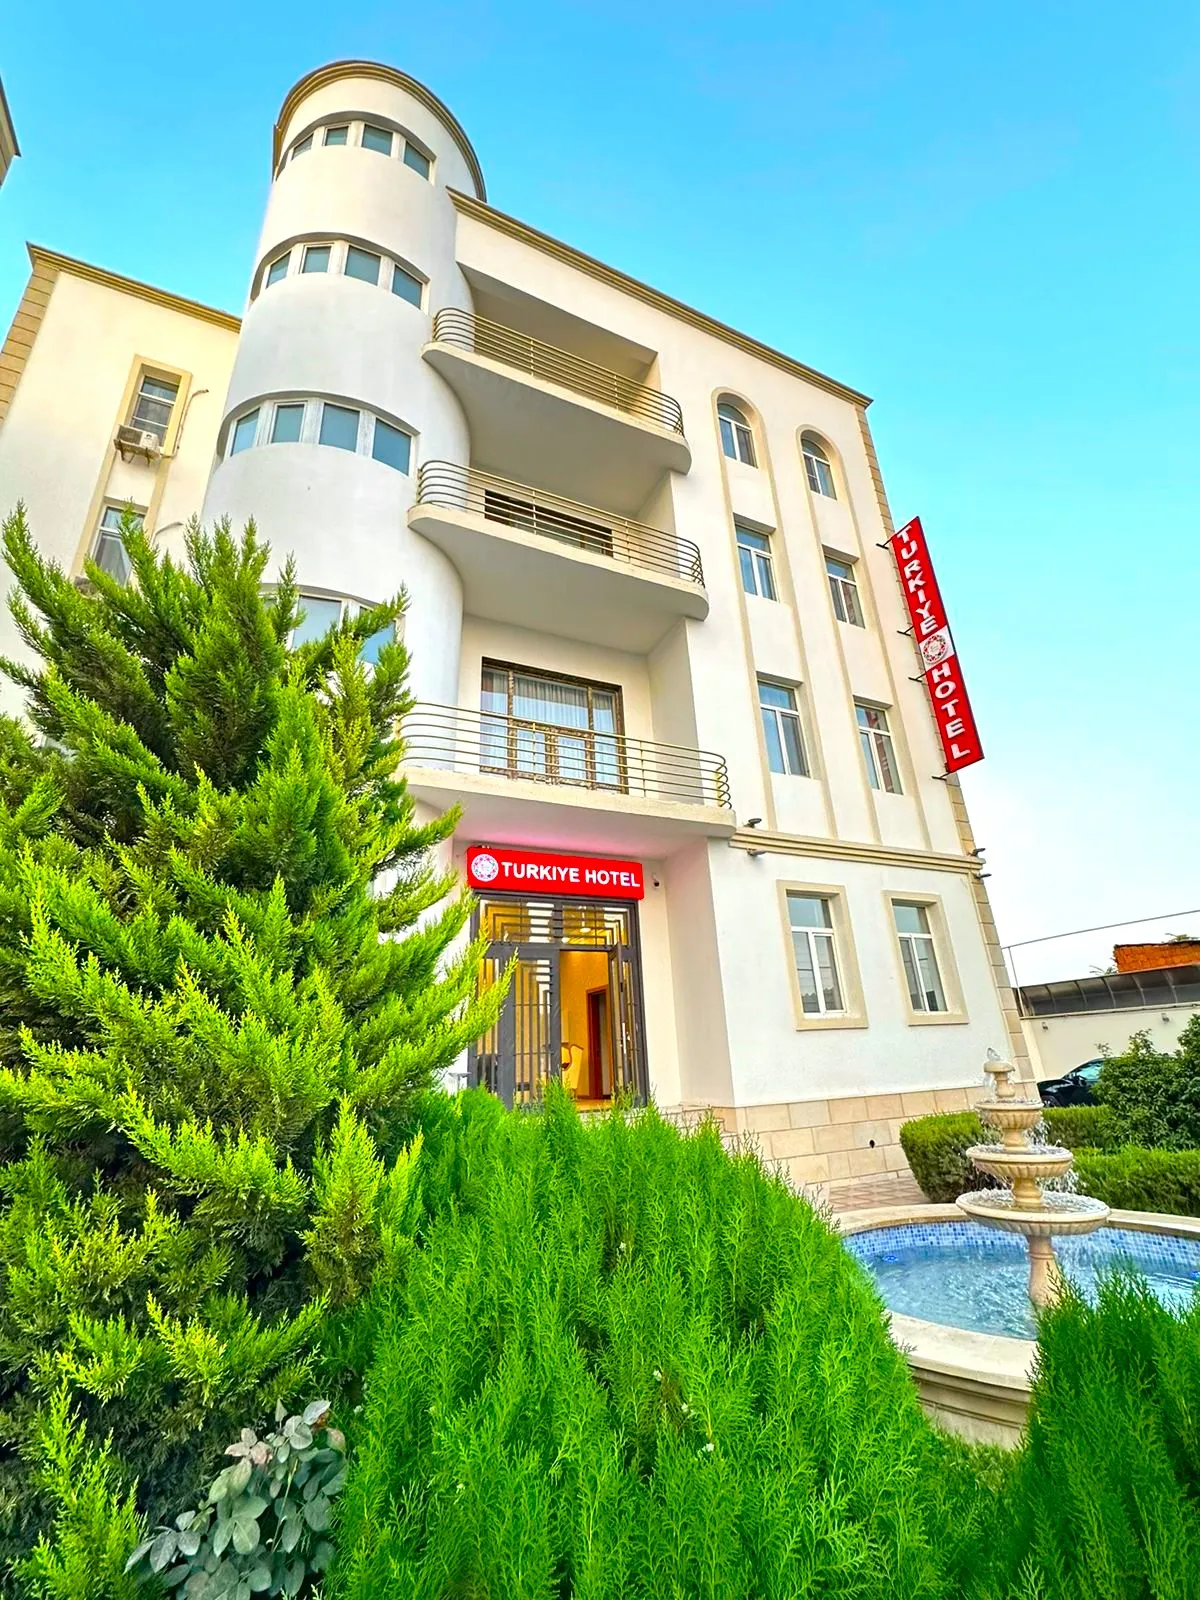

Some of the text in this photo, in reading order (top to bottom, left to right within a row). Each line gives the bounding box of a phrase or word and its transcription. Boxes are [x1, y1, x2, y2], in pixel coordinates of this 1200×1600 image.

[897, 525, 971, 760] TURKIYE HOTEL
[501, 861, 641, 888] TURKIYE HOTEL
